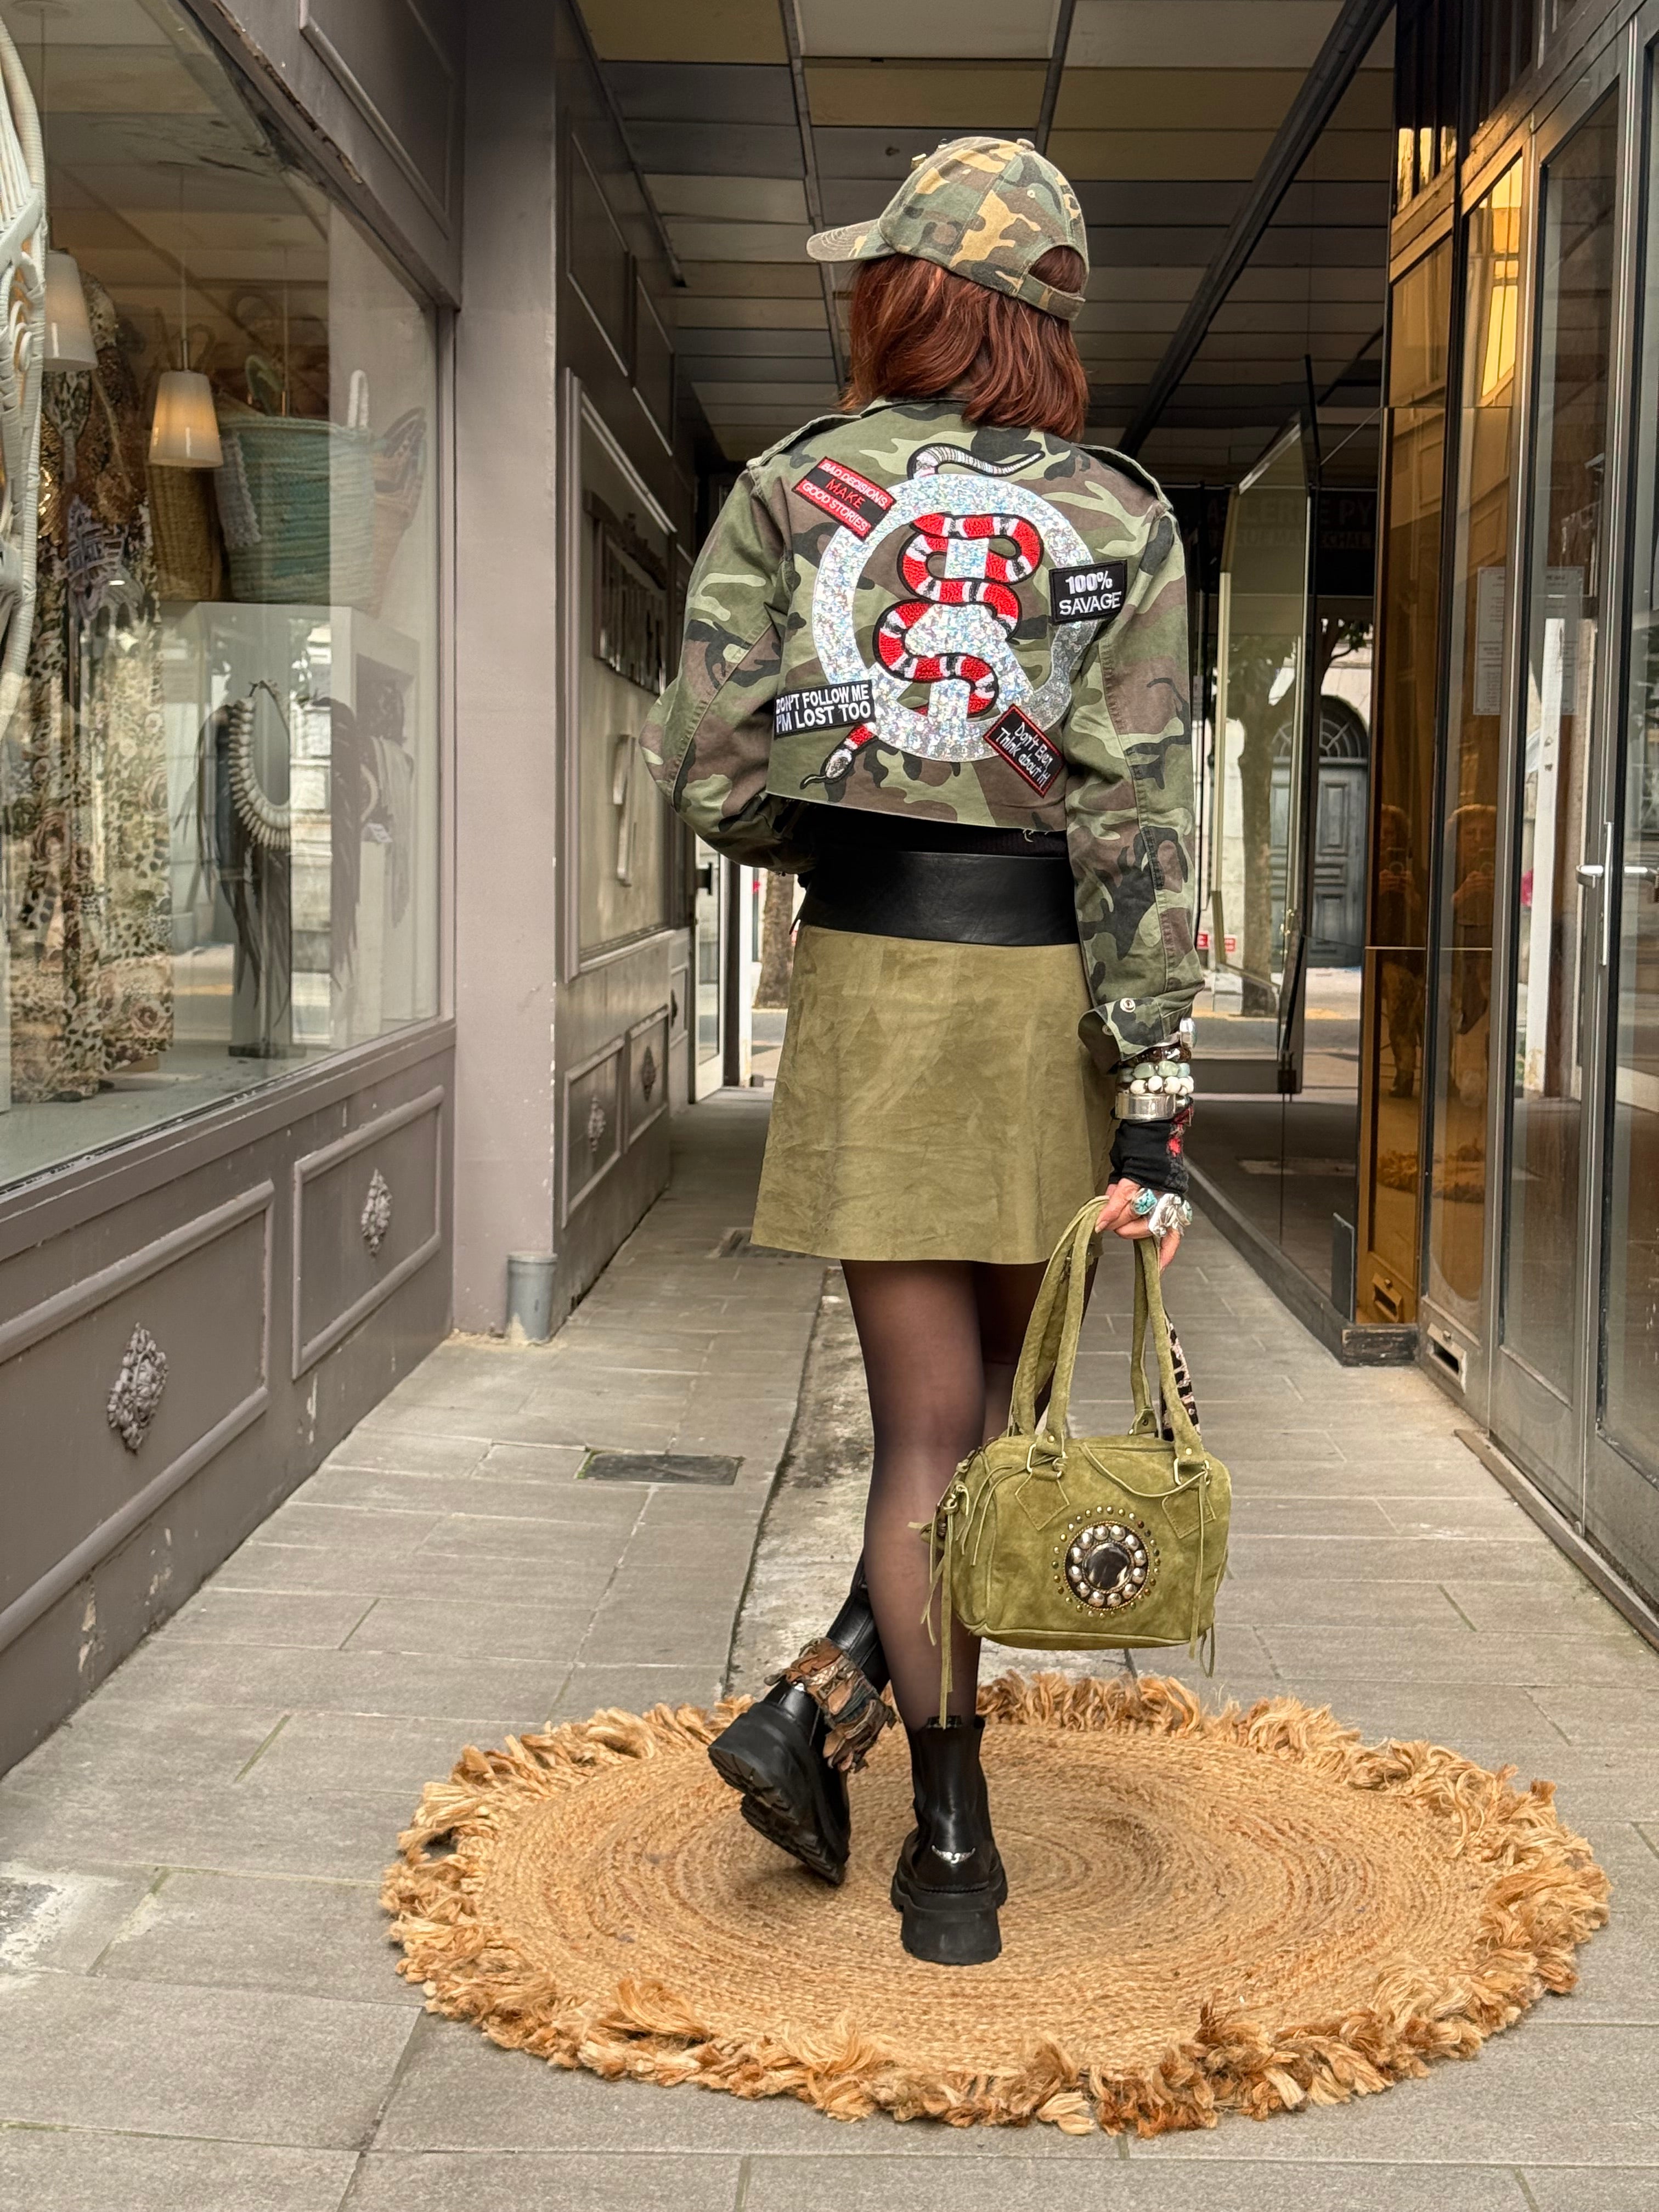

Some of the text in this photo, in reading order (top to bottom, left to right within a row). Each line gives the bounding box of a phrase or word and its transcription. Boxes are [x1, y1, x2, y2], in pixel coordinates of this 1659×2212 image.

[822, 462, 888, 507] BAD DECISIONS
[825, 478, 866, 510] MAKE
[802, 482, 869, 532] GOOD STORIES
[1065, 571, 1113, 594] 100%
[1059, 591, 1122, 615] SAVAGE
[776, 684, 870, 715] DON'T FOLLOW ME
[776, 701, 871, 733] I'M LOST TOO
[1018, 753, 1042, 777] about
[1034, 743, 1053, 769] Even
